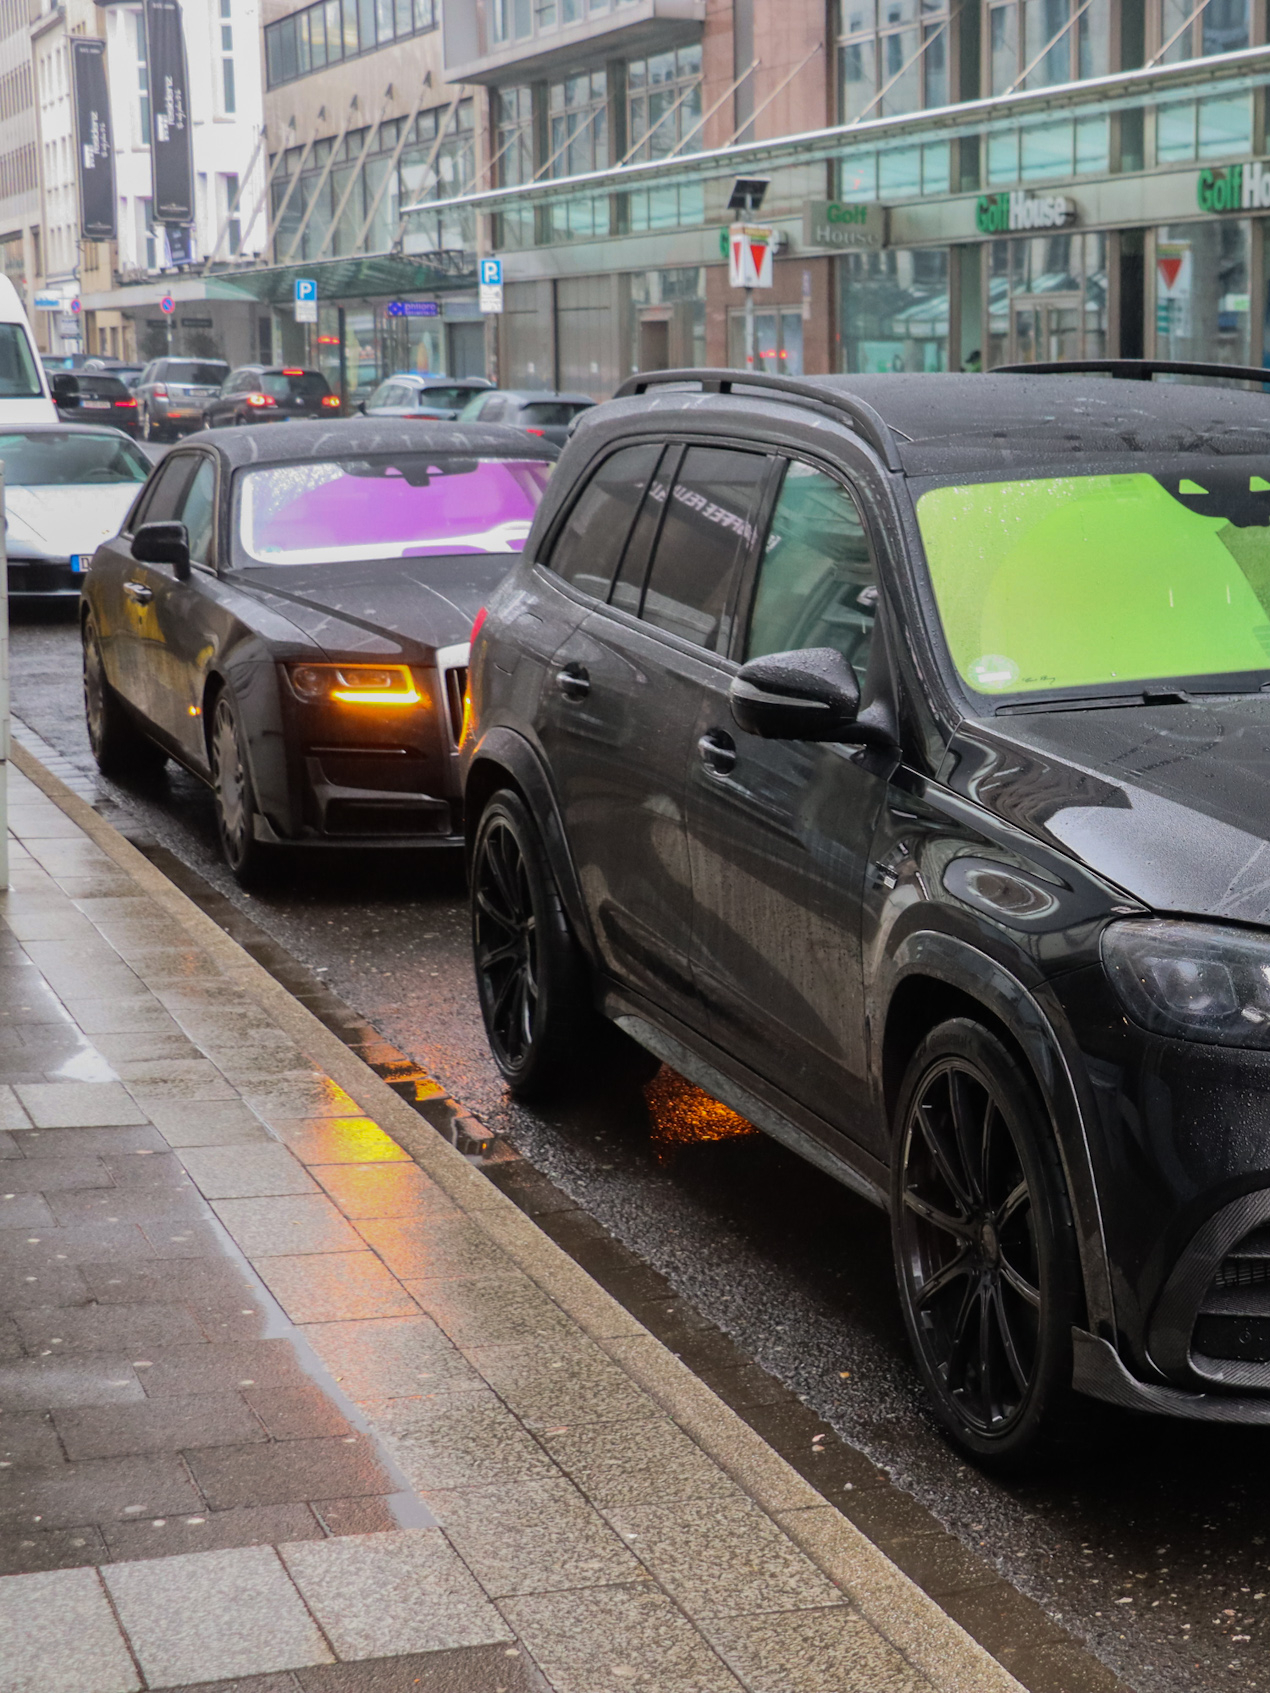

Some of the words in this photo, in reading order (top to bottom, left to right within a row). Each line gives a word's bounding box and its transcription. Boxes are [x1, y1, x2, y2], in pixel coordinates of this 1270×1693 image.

[827, 204, 868, 225] Golf
[816, 225, 880, 245] House
[484, 261, 498, 283] P
[299, 282, 312, 299] P
